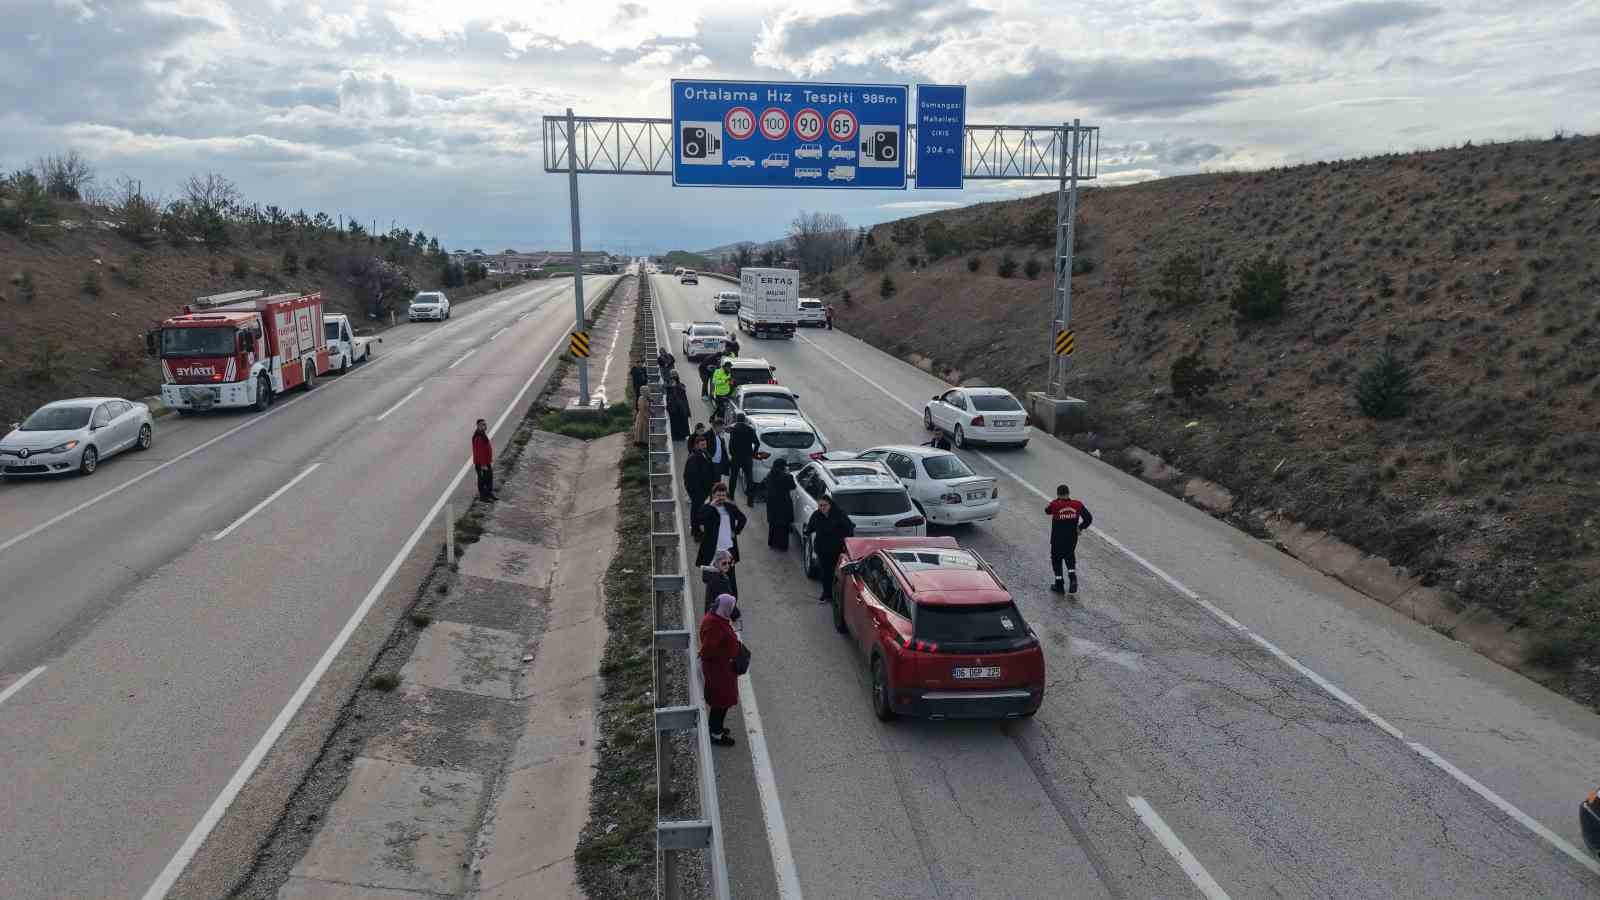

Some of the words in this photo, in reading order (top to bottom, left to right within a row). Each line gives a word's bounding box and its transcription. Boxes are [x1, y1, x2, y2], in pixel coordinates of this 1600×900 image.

[684, 87, 758, 101] Ortalama
[767, 89, 793, 102] Hız
[803, 91, 853, 104] Tespiti
[862, 93, 897, 104] 985m
[731, 118, 750, 130] 110
[765, 118, 785, 130] 100
[800, 118, 818, 132] 90
[833, 119, 850, 134] 85
